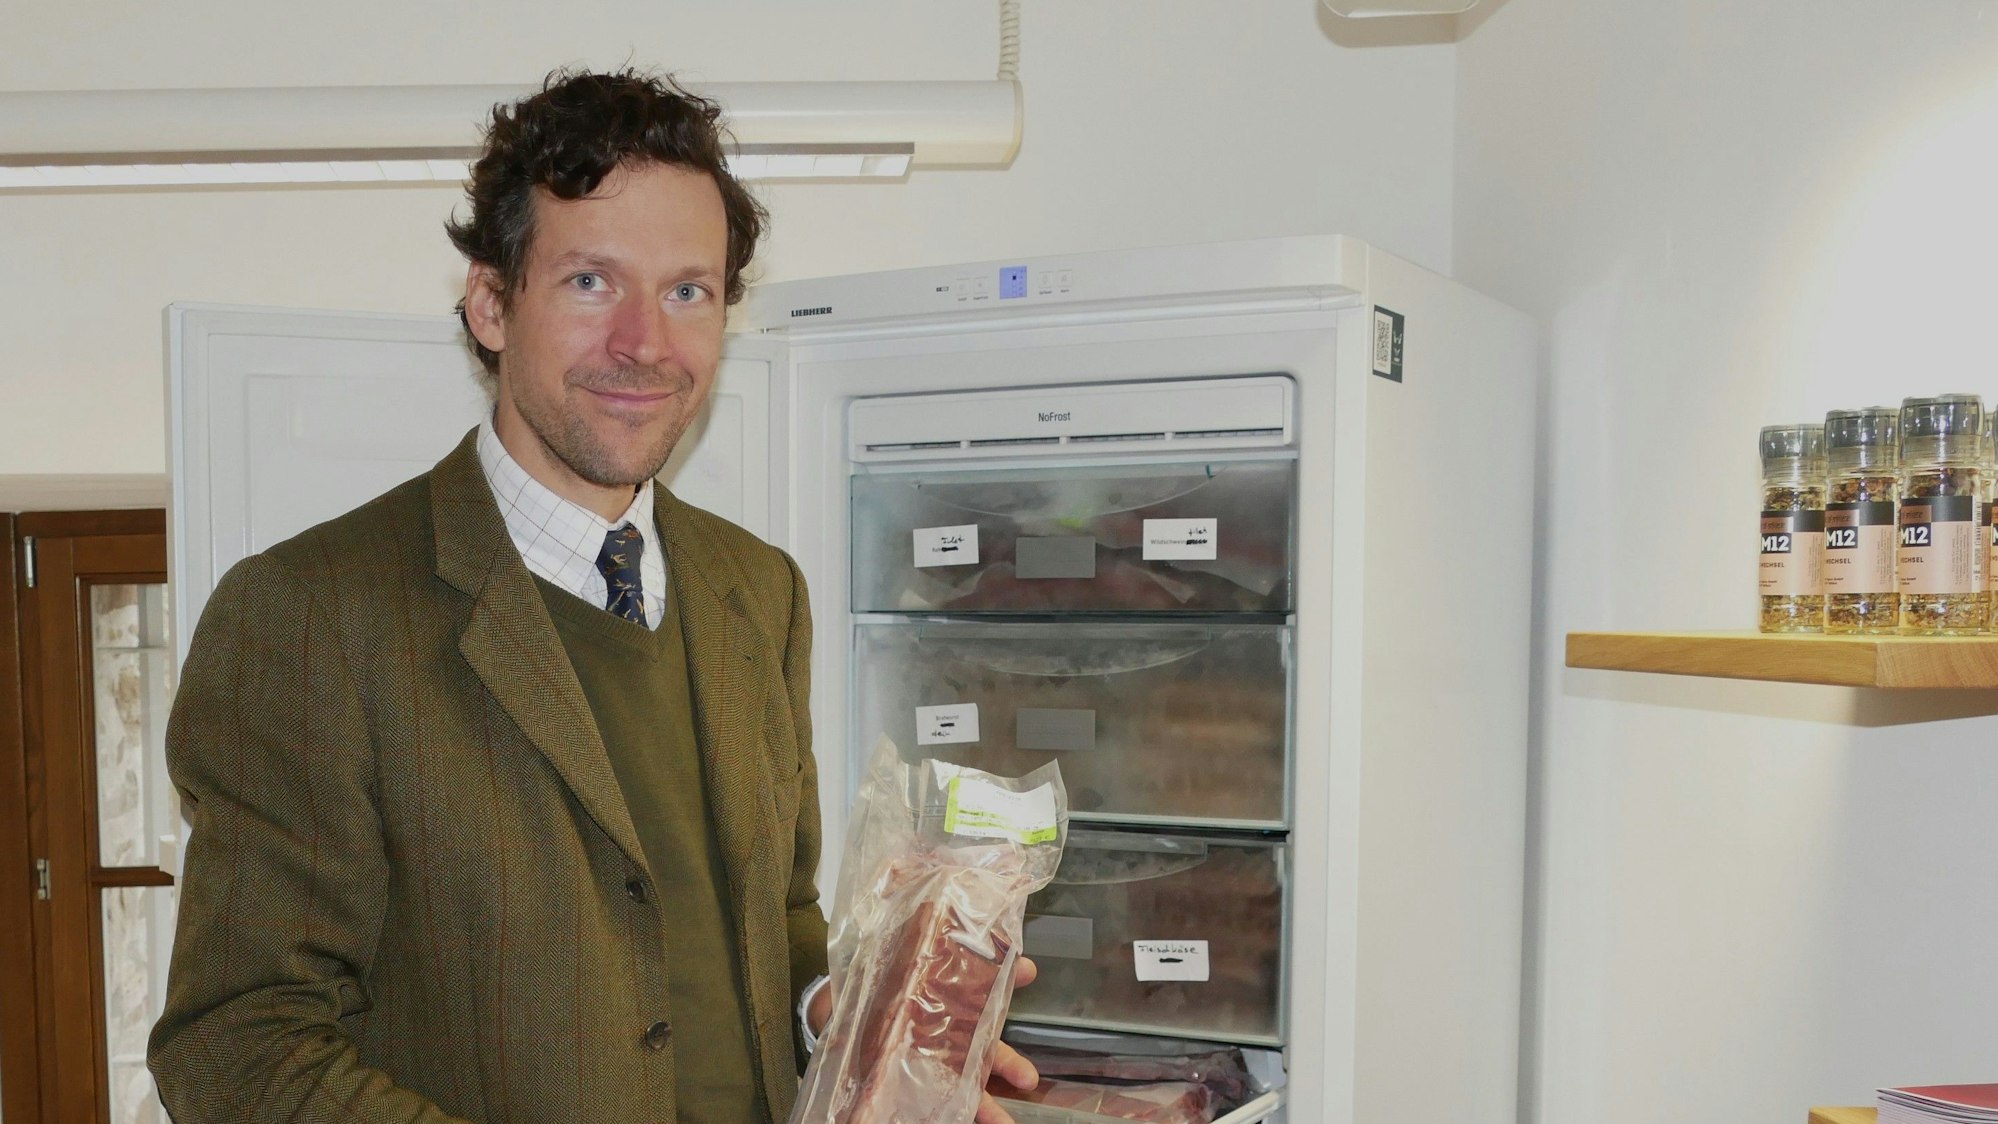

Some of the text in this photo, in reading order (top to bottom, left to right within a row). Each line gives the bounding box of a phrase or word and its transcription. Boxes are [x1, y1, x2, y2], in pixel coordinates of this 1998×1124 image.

[791, 306, 832, 317] LIEBHERR
[1038, 411, 1071, 422] NoFrost
[1761, 535, 1790, 552] M12
[1826, 529, 1856, 547] M12
